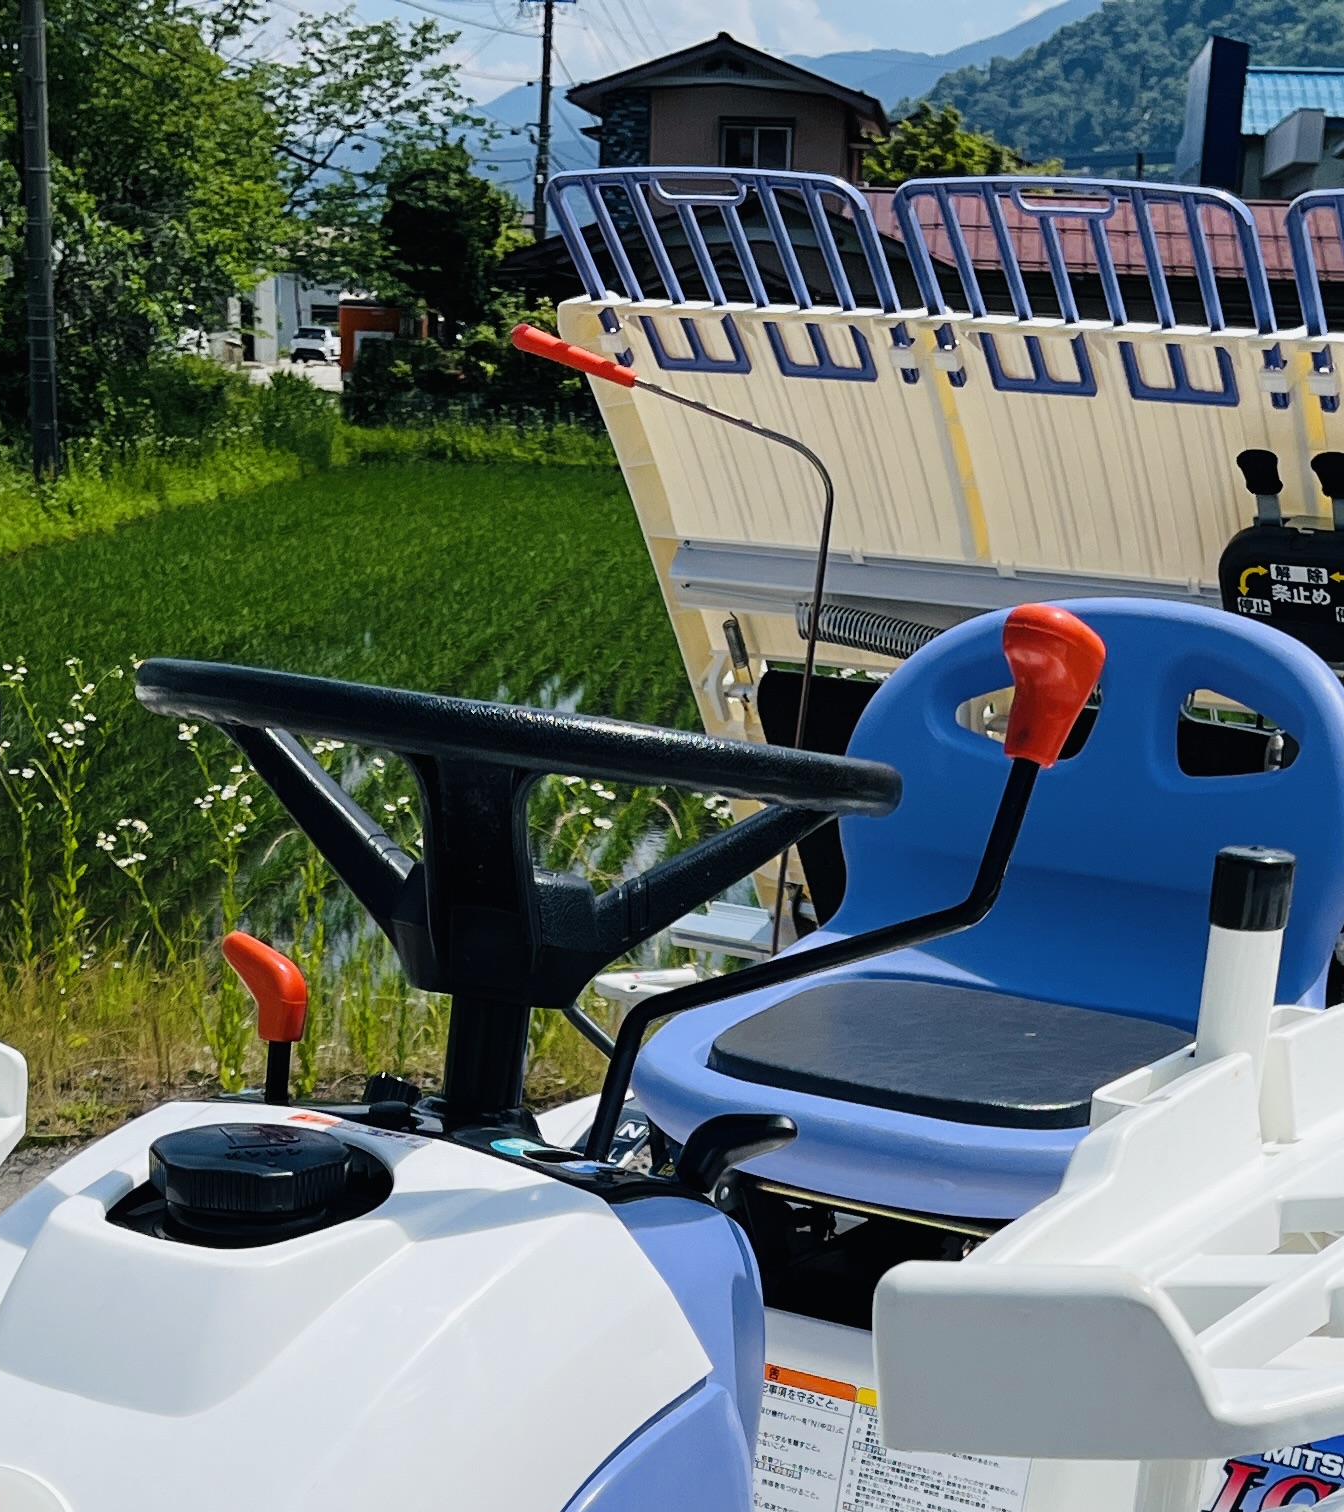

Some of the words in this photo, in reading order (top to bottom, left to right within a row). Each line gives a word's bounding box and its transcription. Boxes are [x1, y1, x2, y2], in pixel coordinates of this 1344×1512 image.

[1271, 583, 1331, 606] 条止め
[1239, 598, 1272, 616] 停止
[617, 1122, 647, 1139] N
